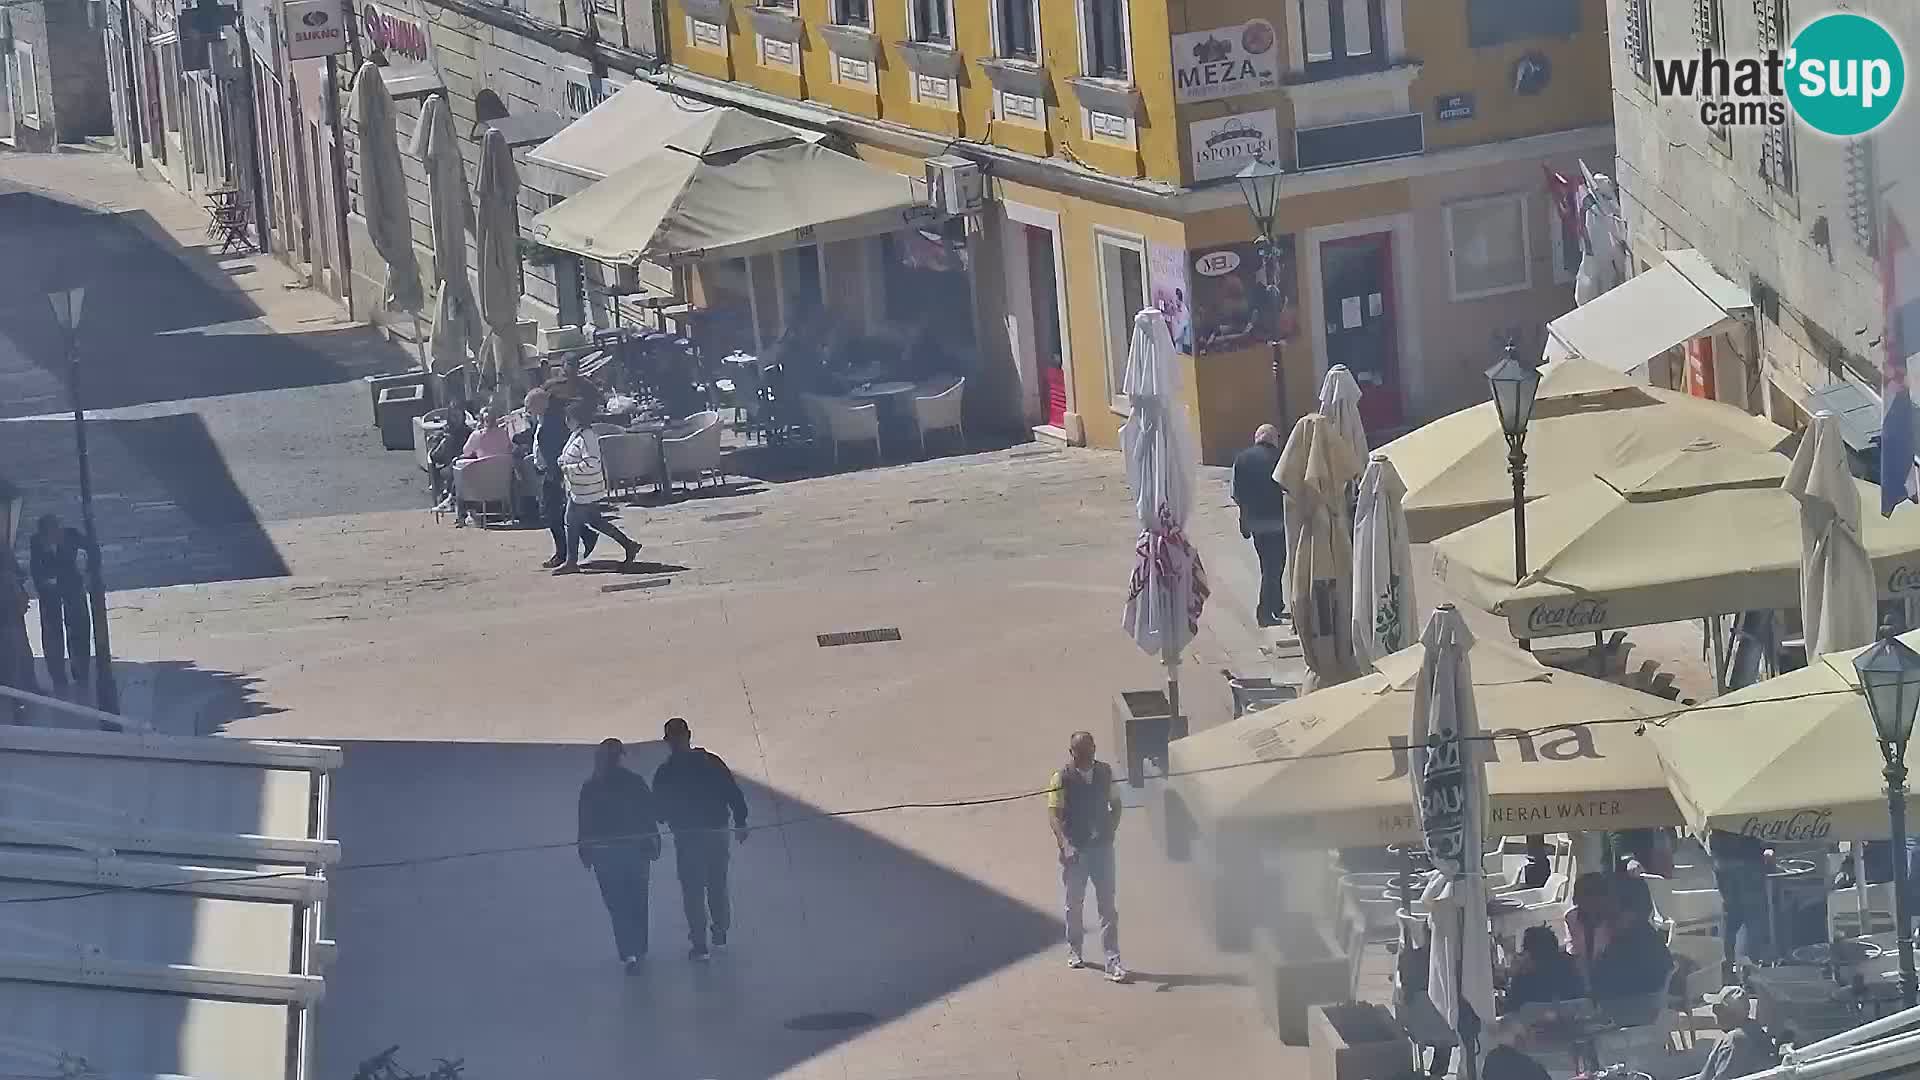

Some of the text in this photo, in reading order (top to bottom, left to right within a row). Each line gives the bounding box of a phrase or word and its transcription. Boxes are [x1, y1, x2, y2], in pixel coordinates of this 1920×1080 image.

[295, 28, 339, 42] SUKNO
[1177, 59, 1257, 89] MEZA
[1197, 144, 1242, 163] ISPOD
[1376, 724, 1606, 782] Jna
[1557, 801, 1621, 818] WATER
